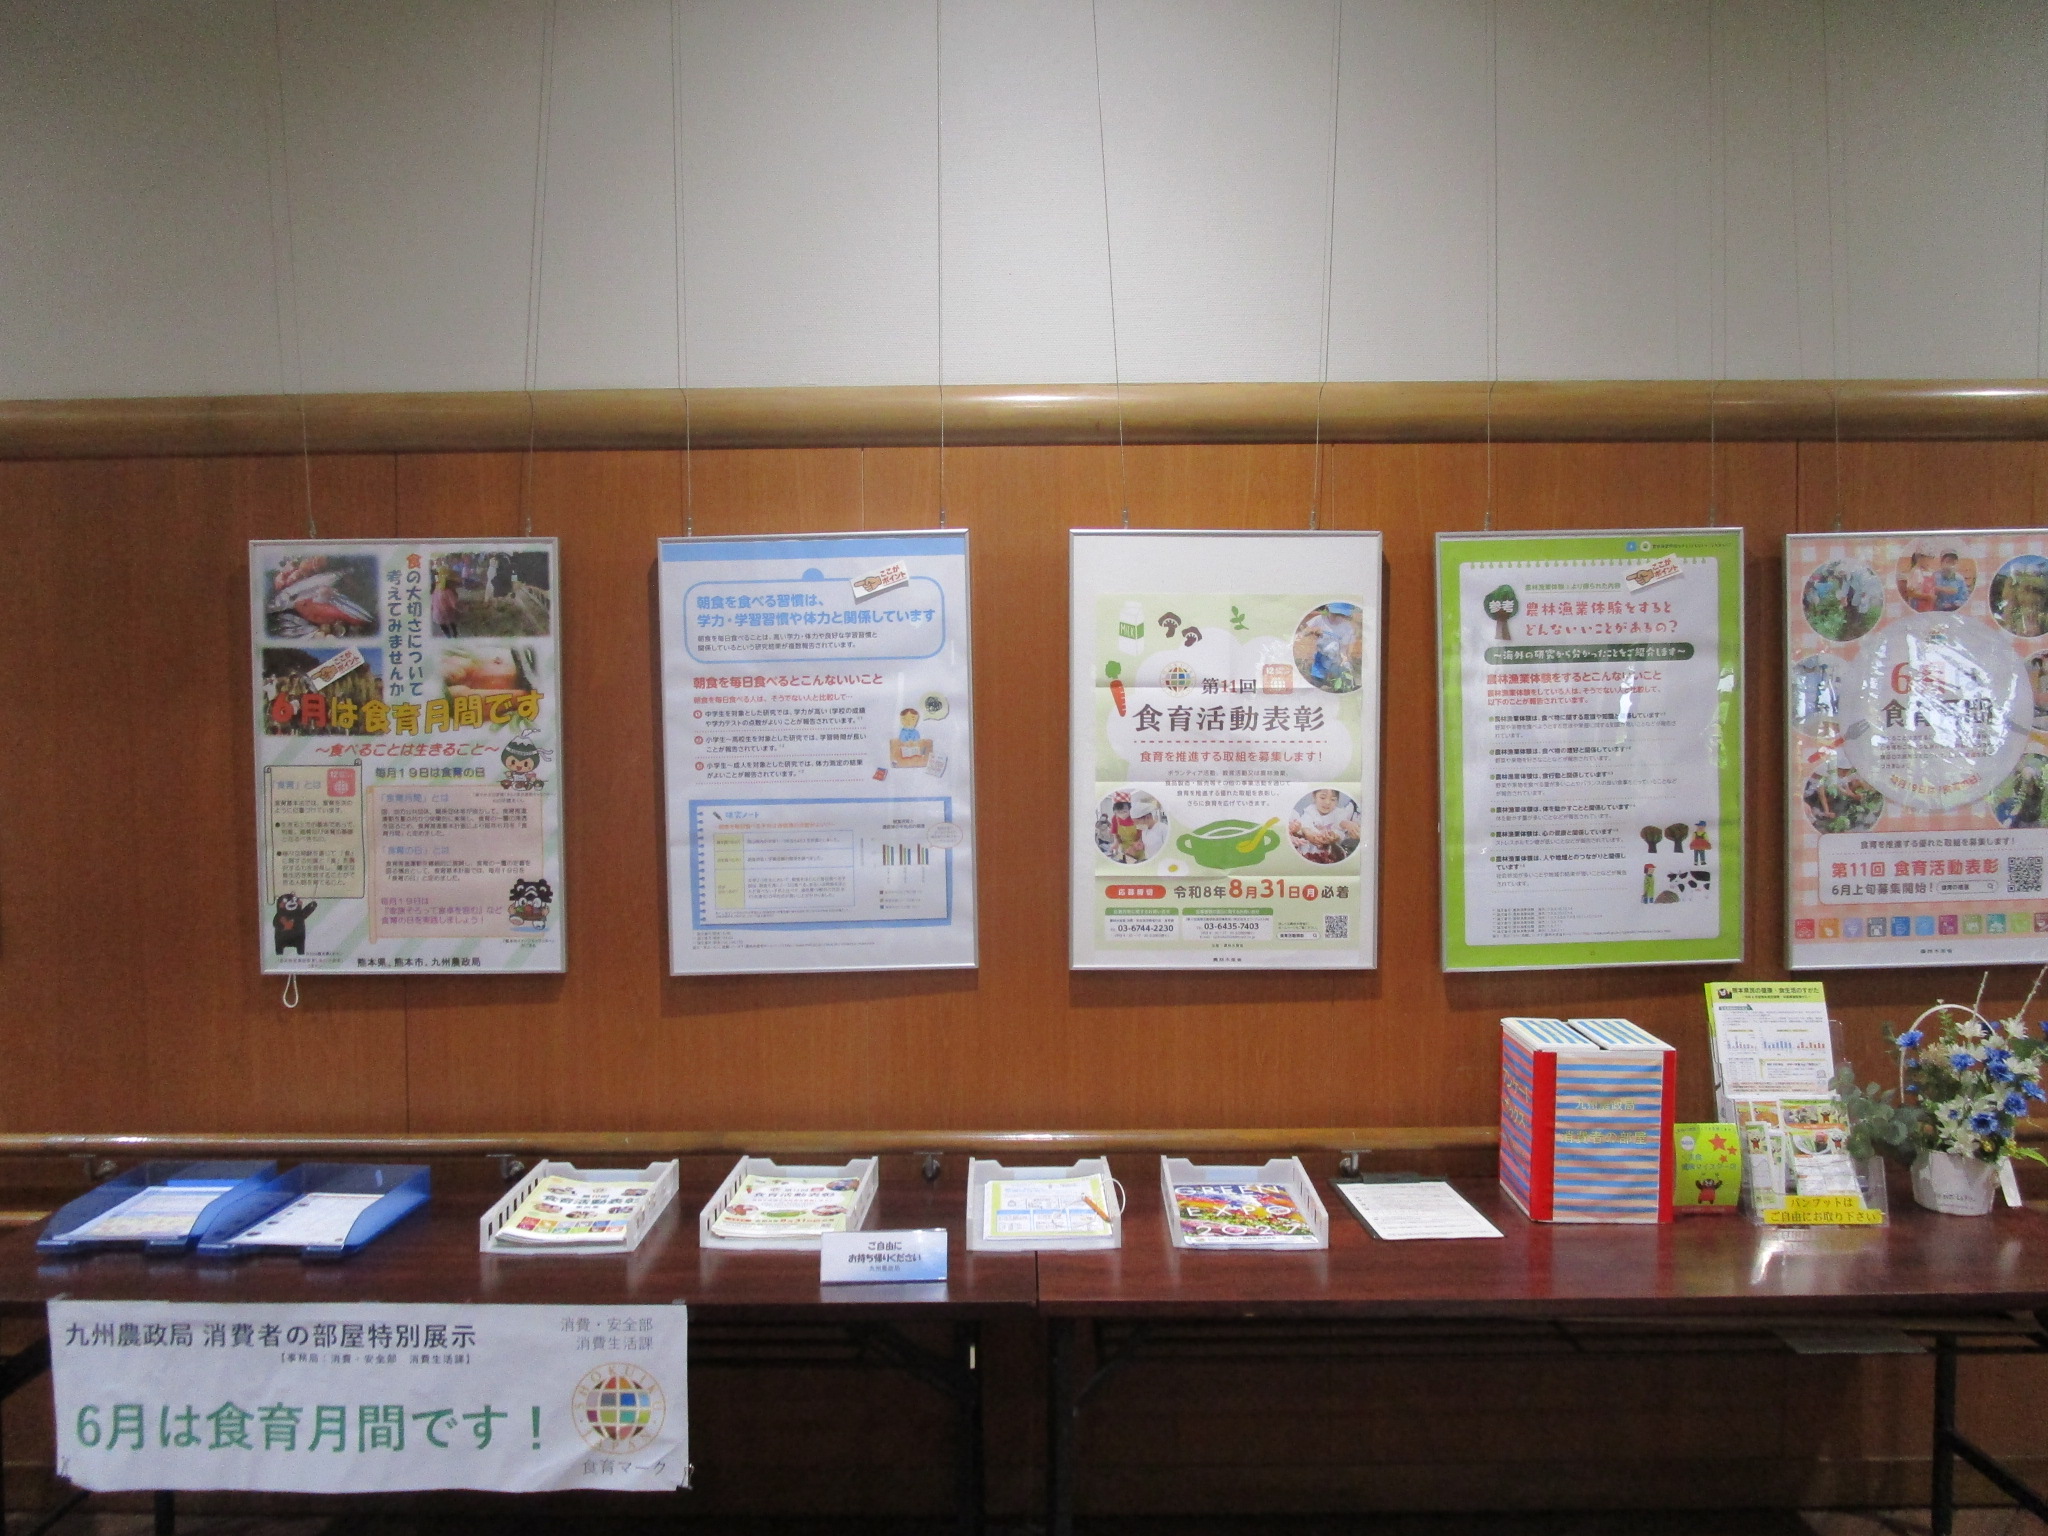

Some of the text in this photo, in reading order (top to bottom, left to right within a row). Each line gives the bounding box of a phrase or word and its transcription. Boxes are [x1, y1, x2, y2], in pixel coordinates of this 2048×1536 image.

[880, 564, 900, 578] ここが
[1652, 558, 1672, 573] ここが
[1654, 563, 1679, 578] ポイント
[882, 571, 907, 585] ポイント
[697, 594, 824, 609] 朝食を食べる習慣は、
[1526, 600, 1672, 617] 農林漁業体験をすると
[406, 553, 424, 697] 食の大切さについて
[697, 608, 936, 628] 学力・学習習慣や体力と関係しています
[387, 570, 404, 697] 考えてみませんか
[693, 673, 884, 689] 朝食を毎日食べるとこんないいこと
[1201, 677, 1257, 695] 第11回
[272, 689, 544, 736] 6月は食育月間です
[1133, 703, 1325, 732] 食育活動表彰
[1831, 858, 1999, 879] 第11回 食育活動表彰
[1117, 924, 1174, 933] 03-6744-2230
[1204, 922, 1260, 931] 03-6435-7403
[1175, 1185, 1280, 1196] GREEN
[1187, 1204, 1291, 1217] EXPO
[1770, 1210, 1876, 1222] ご自由にお取り下さい
[1195, 1222, 1302, 1236] 2027
[868, 1241, 902, 1250] ご自由に
[848, 1253, 922, 1263] お持ち帰りください
[560, 1316, 654, 1332] 消費・安全部
[65, 1321, 477, 1349] 九州農政局 消費者の部屋特別展示
[576, 1335, 654, 1351] 消費生活課
[583, 1459, 666, 1476] 食育マーク
